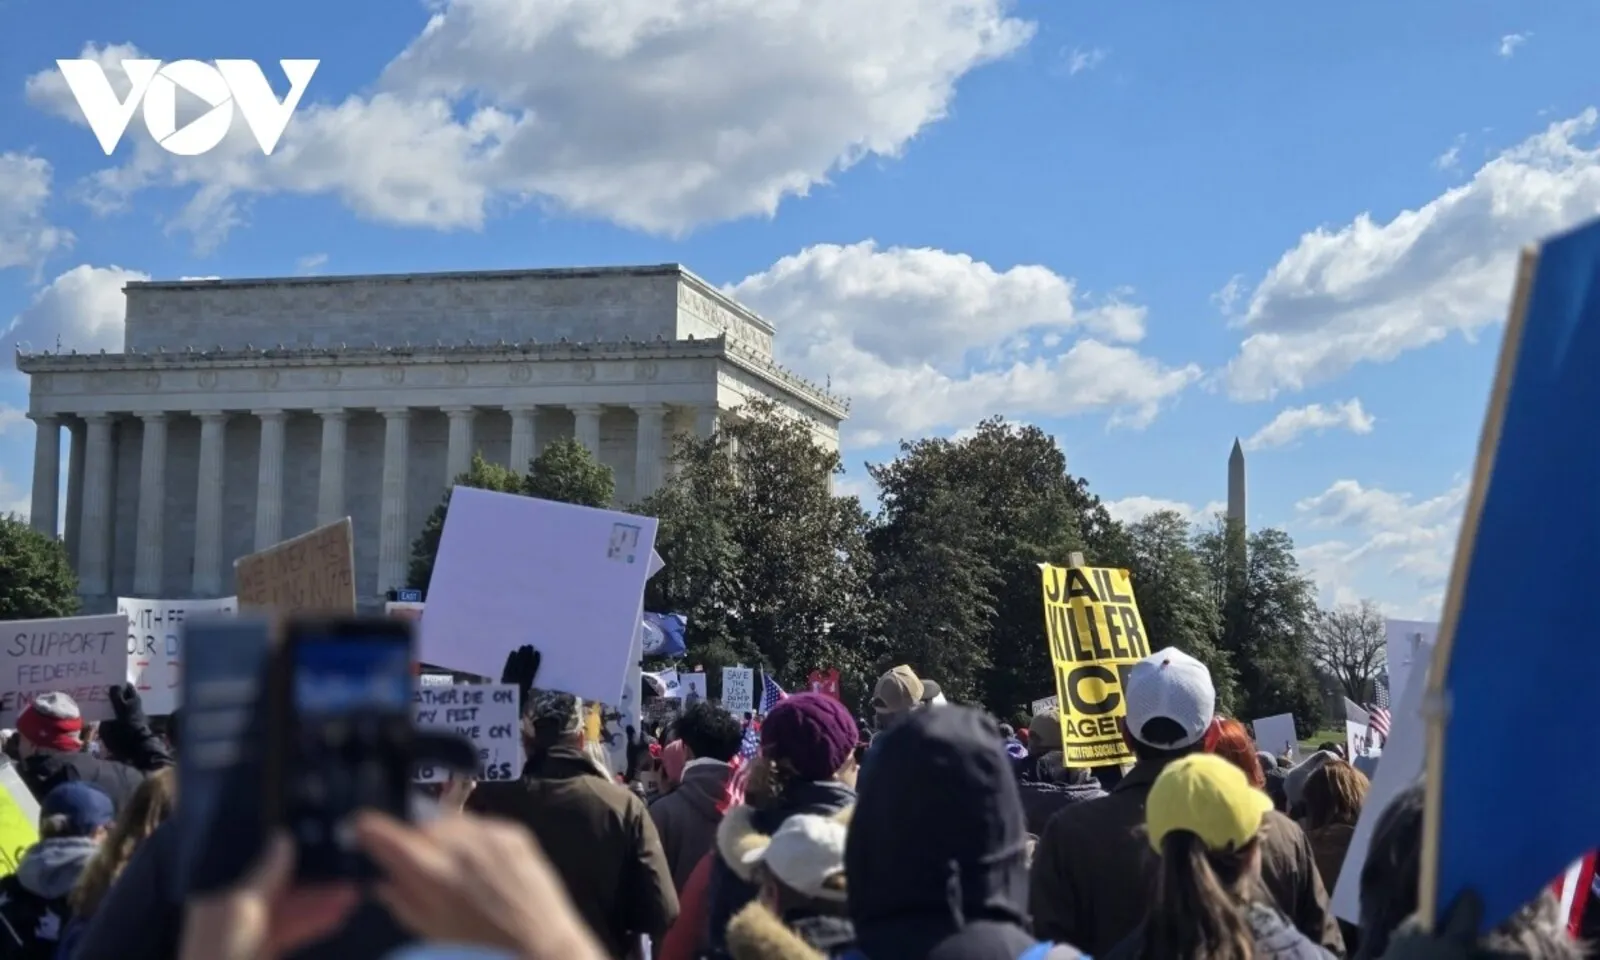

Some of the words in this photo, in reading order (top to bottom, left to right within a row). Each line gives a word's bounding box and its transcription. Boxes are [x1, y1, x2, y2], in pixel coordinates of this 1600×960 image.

[1045, 567, 1131, 604] JAIL
[1047, 604, 1147, 662] KILLER
[7, 631, 116, 657] SUPPORT
[17, 659, 102, 685] FEDERAL
[728, 670, 750, 680] SAVE
[413, 688, 459, 705] ATHER
[493, 690, 514, 704] ON
[417, 709, 438, 723] MY
[456, 725, 481, 739] IVE
[489, 723, 512, 739] ON
